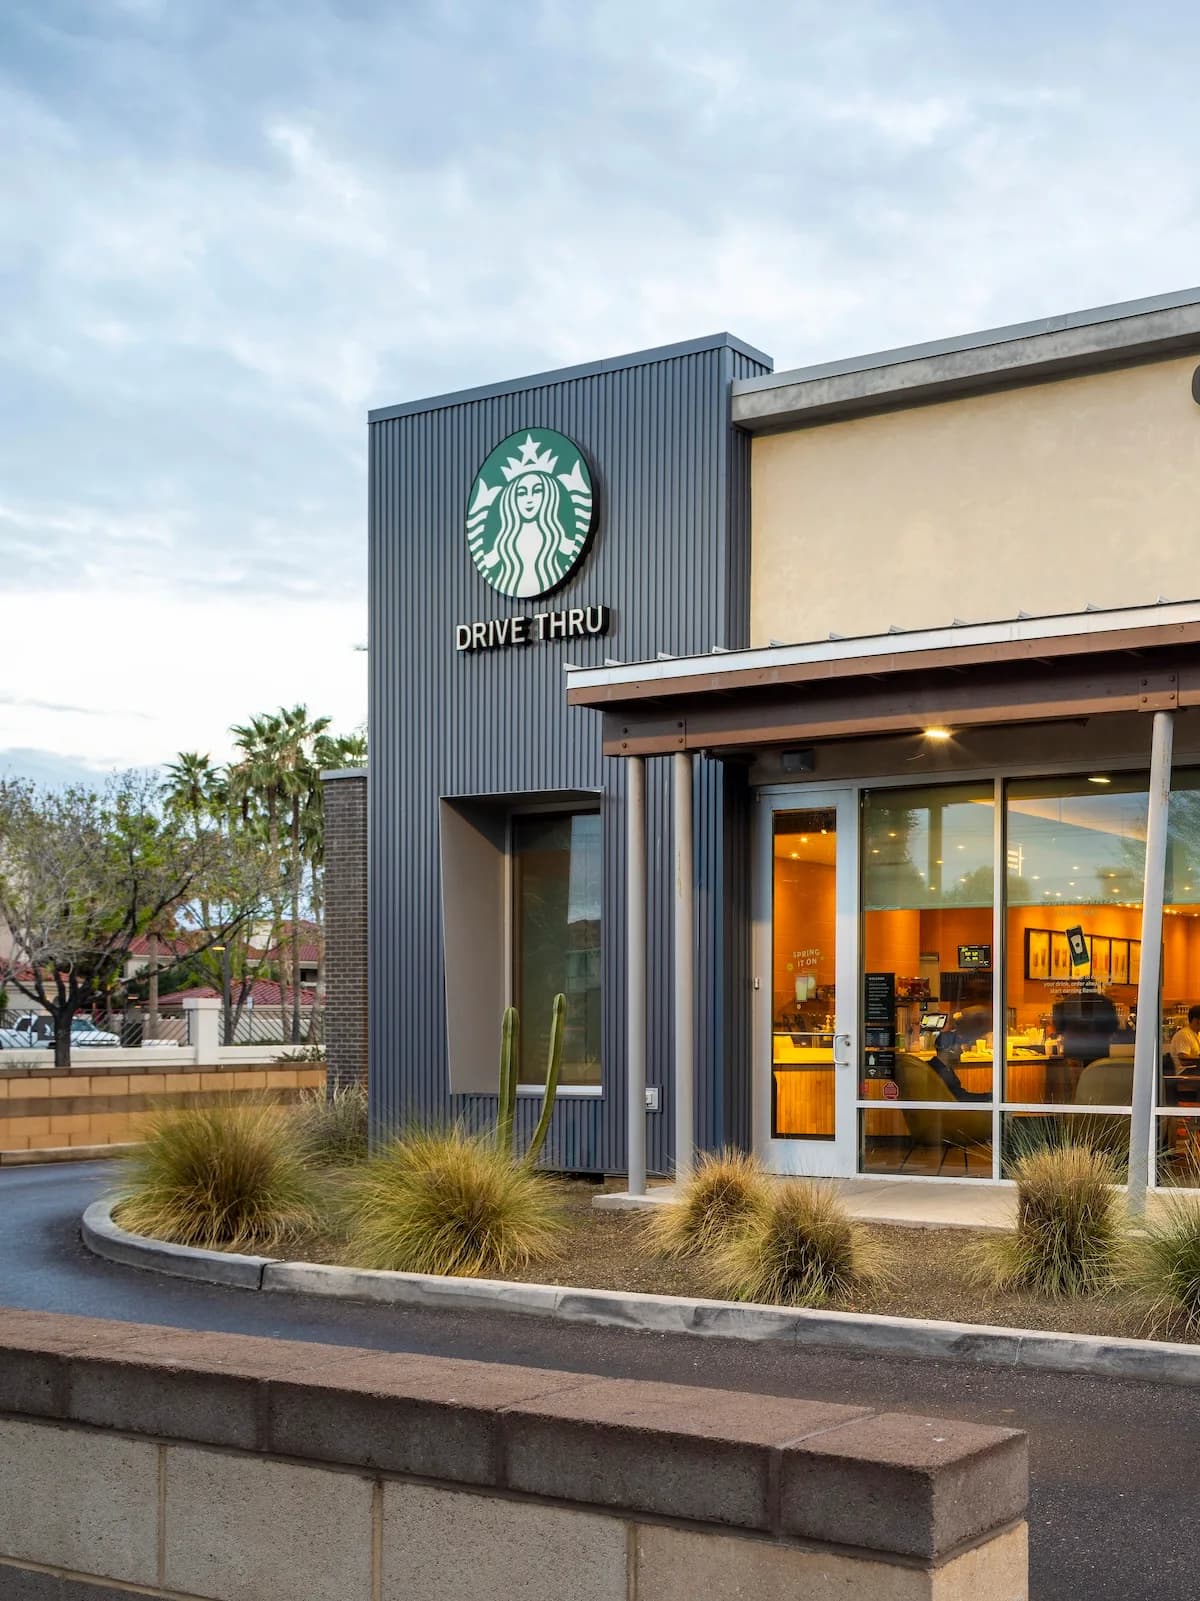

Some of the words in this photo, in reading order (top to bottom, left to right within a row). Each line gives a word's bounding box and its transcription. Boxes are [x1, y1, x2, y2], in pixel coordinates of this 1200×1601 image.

[456, 616, 525, 651] DRIVE
[534, 604, 603, 640] THRU
[792, 948, 820, 959] SPRING
[797, 959, 804, 968] IT
[806, 958, 817, 966] ON
